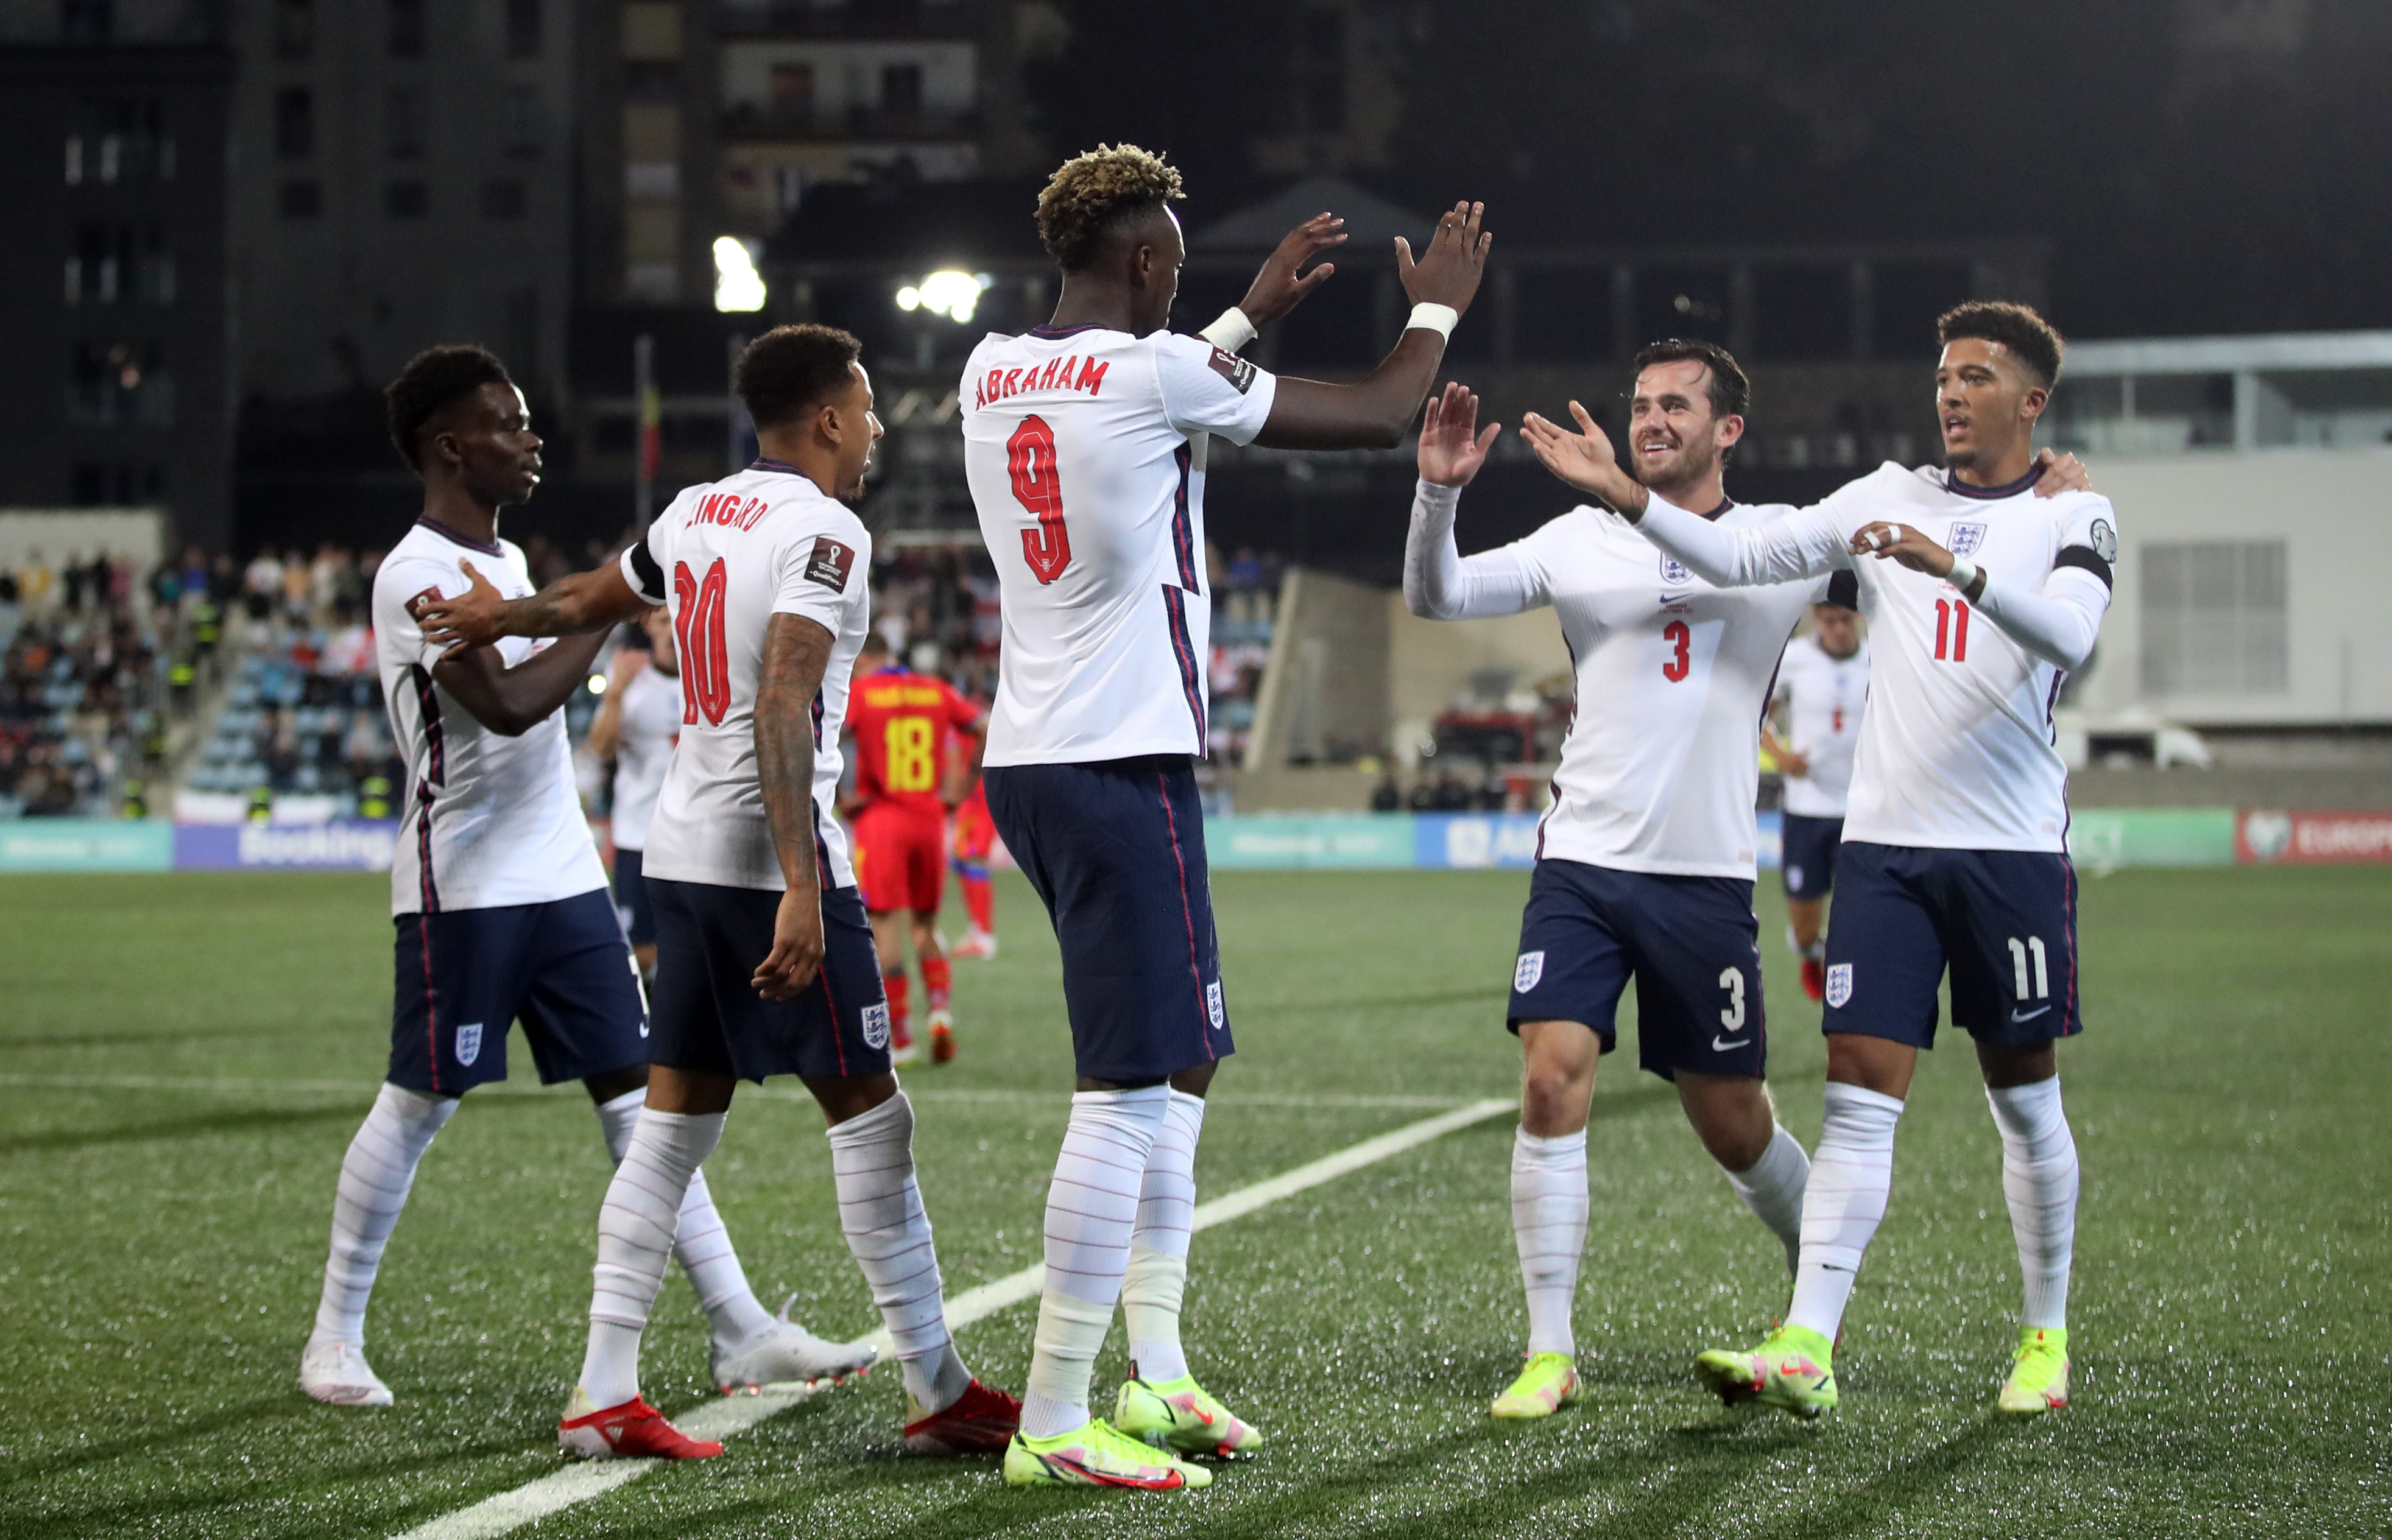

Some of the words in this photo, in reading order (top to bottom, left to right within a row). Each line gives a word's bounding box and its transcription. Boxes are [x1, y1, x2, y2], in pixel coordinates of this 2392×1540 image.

[975, 355, 1110, 411] ABRAHAM
[684, 494, 769, 532] INGRD
[1006, 414, 1071, 585] 9
[674, 557, 731, 726] 10
[1663, 620, 1690, 683] 3
[1934, 598, 1970, 663] 11
[885, 716, 935, 792] 18
[1718, 966, 1745, 1032] 3
[2008, 935, 2048, 1000] 11
